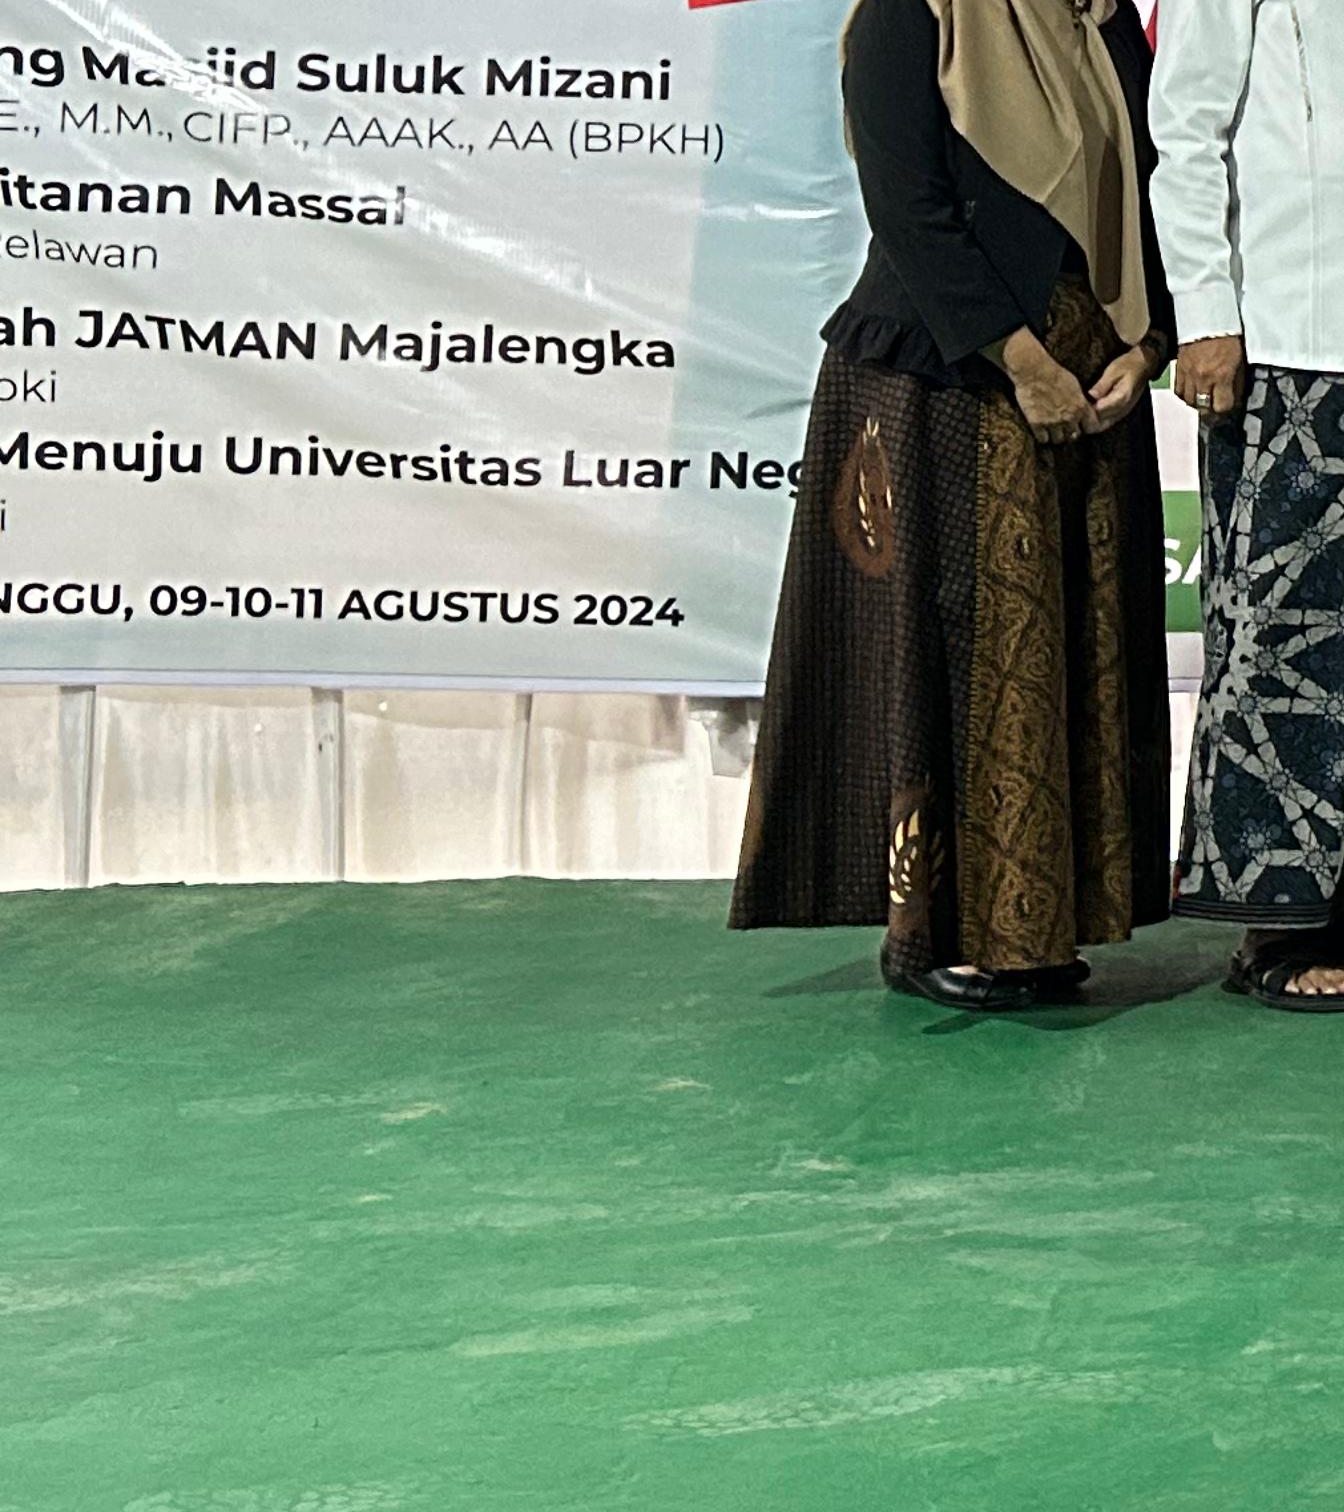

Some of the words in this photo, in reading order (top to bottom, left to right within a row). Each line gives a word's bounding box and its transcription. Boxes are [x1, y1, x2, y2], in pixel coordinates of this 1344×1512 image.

[297, 53, 466, 95] Suluk
[485, 55, 671, 101] Mizani
[60, 100, 173, 143] M.M.,
[323, 115, 475, 156] AAAK.,
[488, 119, 554, 152] AA
[569, 118, 725, 164] (BPKH)
[75, 310, 317, 360] JATMAN
[339, 320, 675, 376] Majalengka
[225, 434, 542, 488] Universitas
[562, 449, 692, 490] Luar
[149, 584, 325, 620] 09-10-11
[337, 589, 560, 625] AGUSTUS
[572, 593, 686, 628] 2024
